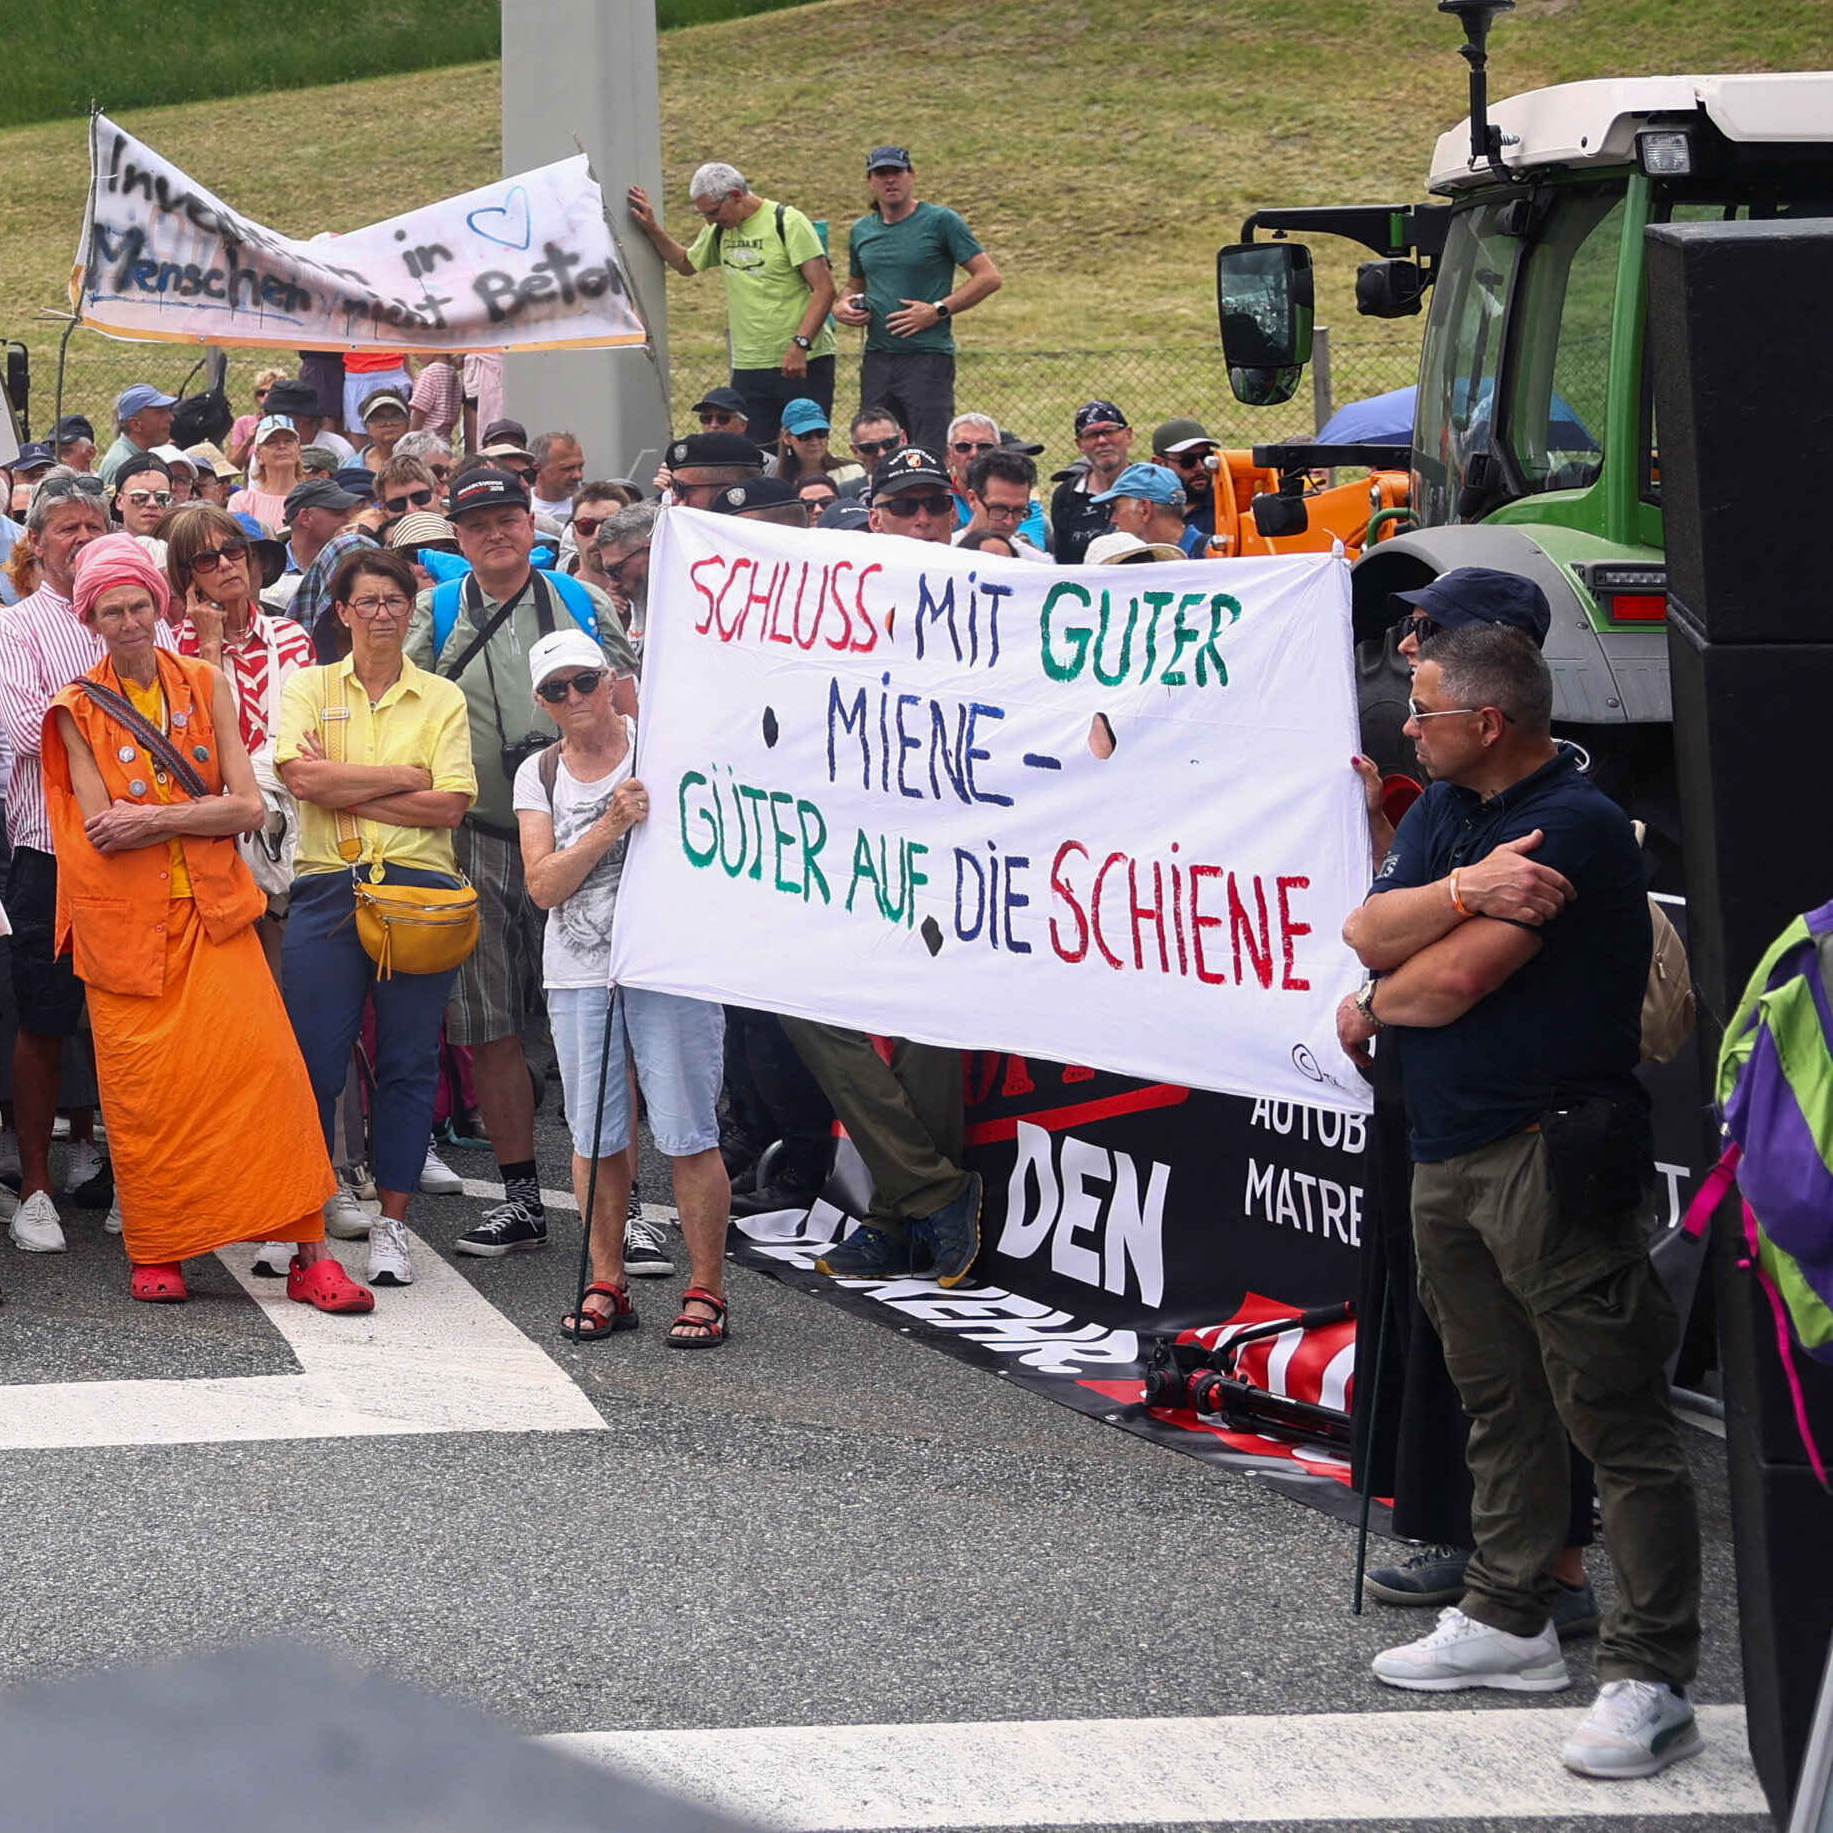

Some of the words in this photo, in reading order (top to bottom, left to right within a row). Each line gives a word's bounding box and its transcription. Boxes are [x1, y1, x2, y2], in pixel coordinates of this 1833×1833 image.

[86, 222, 312, 313] Menschen
[689, 555, 884, 654] SCHLUSS
[915, 571, 1014, 668] MIT
[1040, 581, 1242, 688] GUTER
[678, 763, 832, 906] GÜTER
[845, 827, 930, 930] AUF
[953, 839, 1033, 954] DIE
[1049, 839, 1312, 992] SCHIENE
[996, 1119, 1171, 1309] DEN
